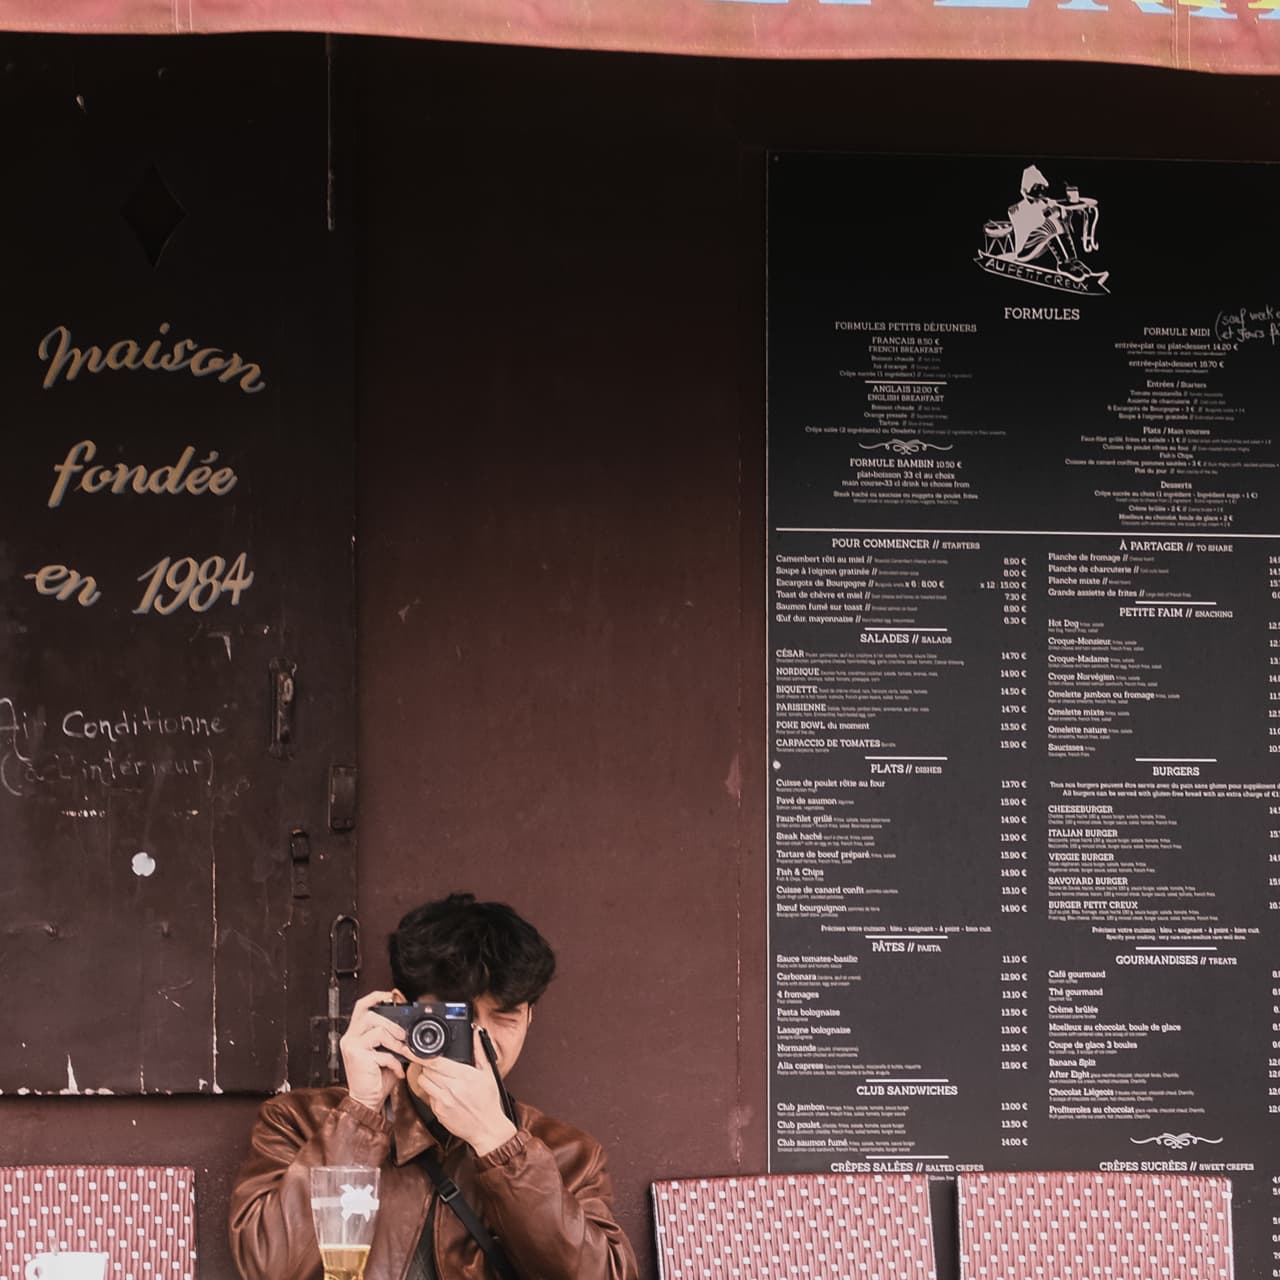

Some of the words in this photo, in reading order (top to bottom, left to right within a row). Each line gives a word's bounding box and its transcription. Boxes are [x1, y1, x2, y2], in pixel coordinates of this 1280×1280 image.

[985, 258, 1004, 271] AU
[1008, 265, 1041, 280] PETIT
[1045, 275, 1088, 291] CREUX
[1004, 308, 1080, 320] FORMULES
[835, 321, 886, 331] FORMULES
[889, 323, 921, 332] PETITS
[923, 322, 977, 332] DÉJEUNERS
[1143, 328, 1188, 336] FORMULE
[1190, 328, 1210, 337] MIDI
[1147, 380, 1174, 388] Entrées
[934, 386, 939, 394] €
[850, 458, 895, 467] FORMULE
[897, 459, 934, 468] BAMBIN
[956, 461, 962, 469] €
[48, 439, 238, 509] fondée
[1161, 481, 1193, 489] Desserts
[832, 539, 861, 549] POUR
[863, 539, 929, 549] COMMENCER
[942, 541, 980, 549] STARTERS
[1120, 539, 1127, 551] À
[1130, 542, 1184, 552] PARTAGER
[1196, 544, 1207, 552] TO
[1209, 544, 1233, 552] SHARE
[776, 554, 819, 564] Camembert
[822, 555, 835, 564] rôti
[849, 556, 864, 564] miel
[1048, 553, 1077, 562] Planche
[1079, 554, 1088, 562] de
[1090, 554, 1121, 564] fromage
[776, 567, 799, 577] Soupe
[838, 568, 870, 577] gratinée
[24, 564, 102, 607] en
[132, 552, 254, 616] 1984
[776, 579, 813, 589] Escargots
[815, 580, 824, 588] de
[826, 580, 866, 589] Bourgogne
[1048, 577, 1077, 586] Planche
[1079, 578, 1100, 586] mixte
[1120, 608, 1155, 617] PETITE
[1158, 608, 1183, 618] FAIM
[1195, 611, 1233, 619] SNACKING
[1048, 620, 1062, 628] Hot
[1064, 620, 1079, 630] Dog
[860, 634, 910, 644] SALADES
[921, 636, 952, 644] SALADS
[1048, 638, 1111, 647] Croque-Monsieur
[776, 649, 804, 658] CÉSAR
[1048, 655, 1109, 665] Croque-Madame
[776, 668, 819, 677] NORDIQUE
[1048, 673, 1074, 683] Croque
[1077, 673, 1115, 683] Norvégien
[776, 686, 818, 694] BIQUETTE
[776, 703, 826, 712] PARISIENNE
[776, 721, 799, 729] POKE
[801, 721, 826, 730] BOWL
[828, 722, 837, 730] du
[839, 722, 870, 730] moment
[776, 739, 825, 747] CARPACCIO
[827, 739, 838, 747] DE
[840, 739, 881, 748] TOMATES
[871, 764, 904, 774] PLATS
[915, 766, 942, 774] DISHES
[1153, 766, 1200, 776] BURGERS
[1048, 805, 1113, 813] CHEESEBURGER
[1048, 829, 1083, 837] ITALIAN
[1085, 829, 1118, 837] BURGER
[1048, 853, 1080, 861] VEGGIE
[1082, 853, 1115, 862] BURGER
[776, 868, 792, 876] Fish
[794, 868, 801, 876] &
[802, 868, 824, 878] Chips
[1048, 877, 1093, 885] SAVOYARD
[1095, 877, 1128, 885] BURGER
[1048, 901, 1082, 909] BURGER
[1083, 901, 1108, 909] PETIT
[1110, 901, 1138, 909] CREUX
[872, 940, 905, 952] PÂTES
[1116, 956, 1199, 965] GOURMANDISES
[1209, 957, 1237, 965] TREATS
[777, 973, 817, 981] Carbonara
[1048, 971, 1066, 979] Café
[1068, 971, 1106, 980] gourmand
[1048, 1006, 1073, 1014] Crème
[1075, 1006, 1098, 1015] brûlée
[1049, 1070, 1069, 1078] After
[1071, 1070, 1090, 1080] Eight
[857, 1086, 885, 1096] CLUB
[887, 1086, 958, 1096] SANDWICHES
[777, 1103, 795, 1111] Club
[797, 1103, 825, 1112] jambon
[831, 1161, 871, 1173] CRÊPES
[873, 1162, 914, 1173] SALÉES
[925, 1164, 954, 1172] SALTED
[1099, 1160, 1139, 1171] CRÊPES
[1141, 1160, 1187, 1171] SUCRÉES
